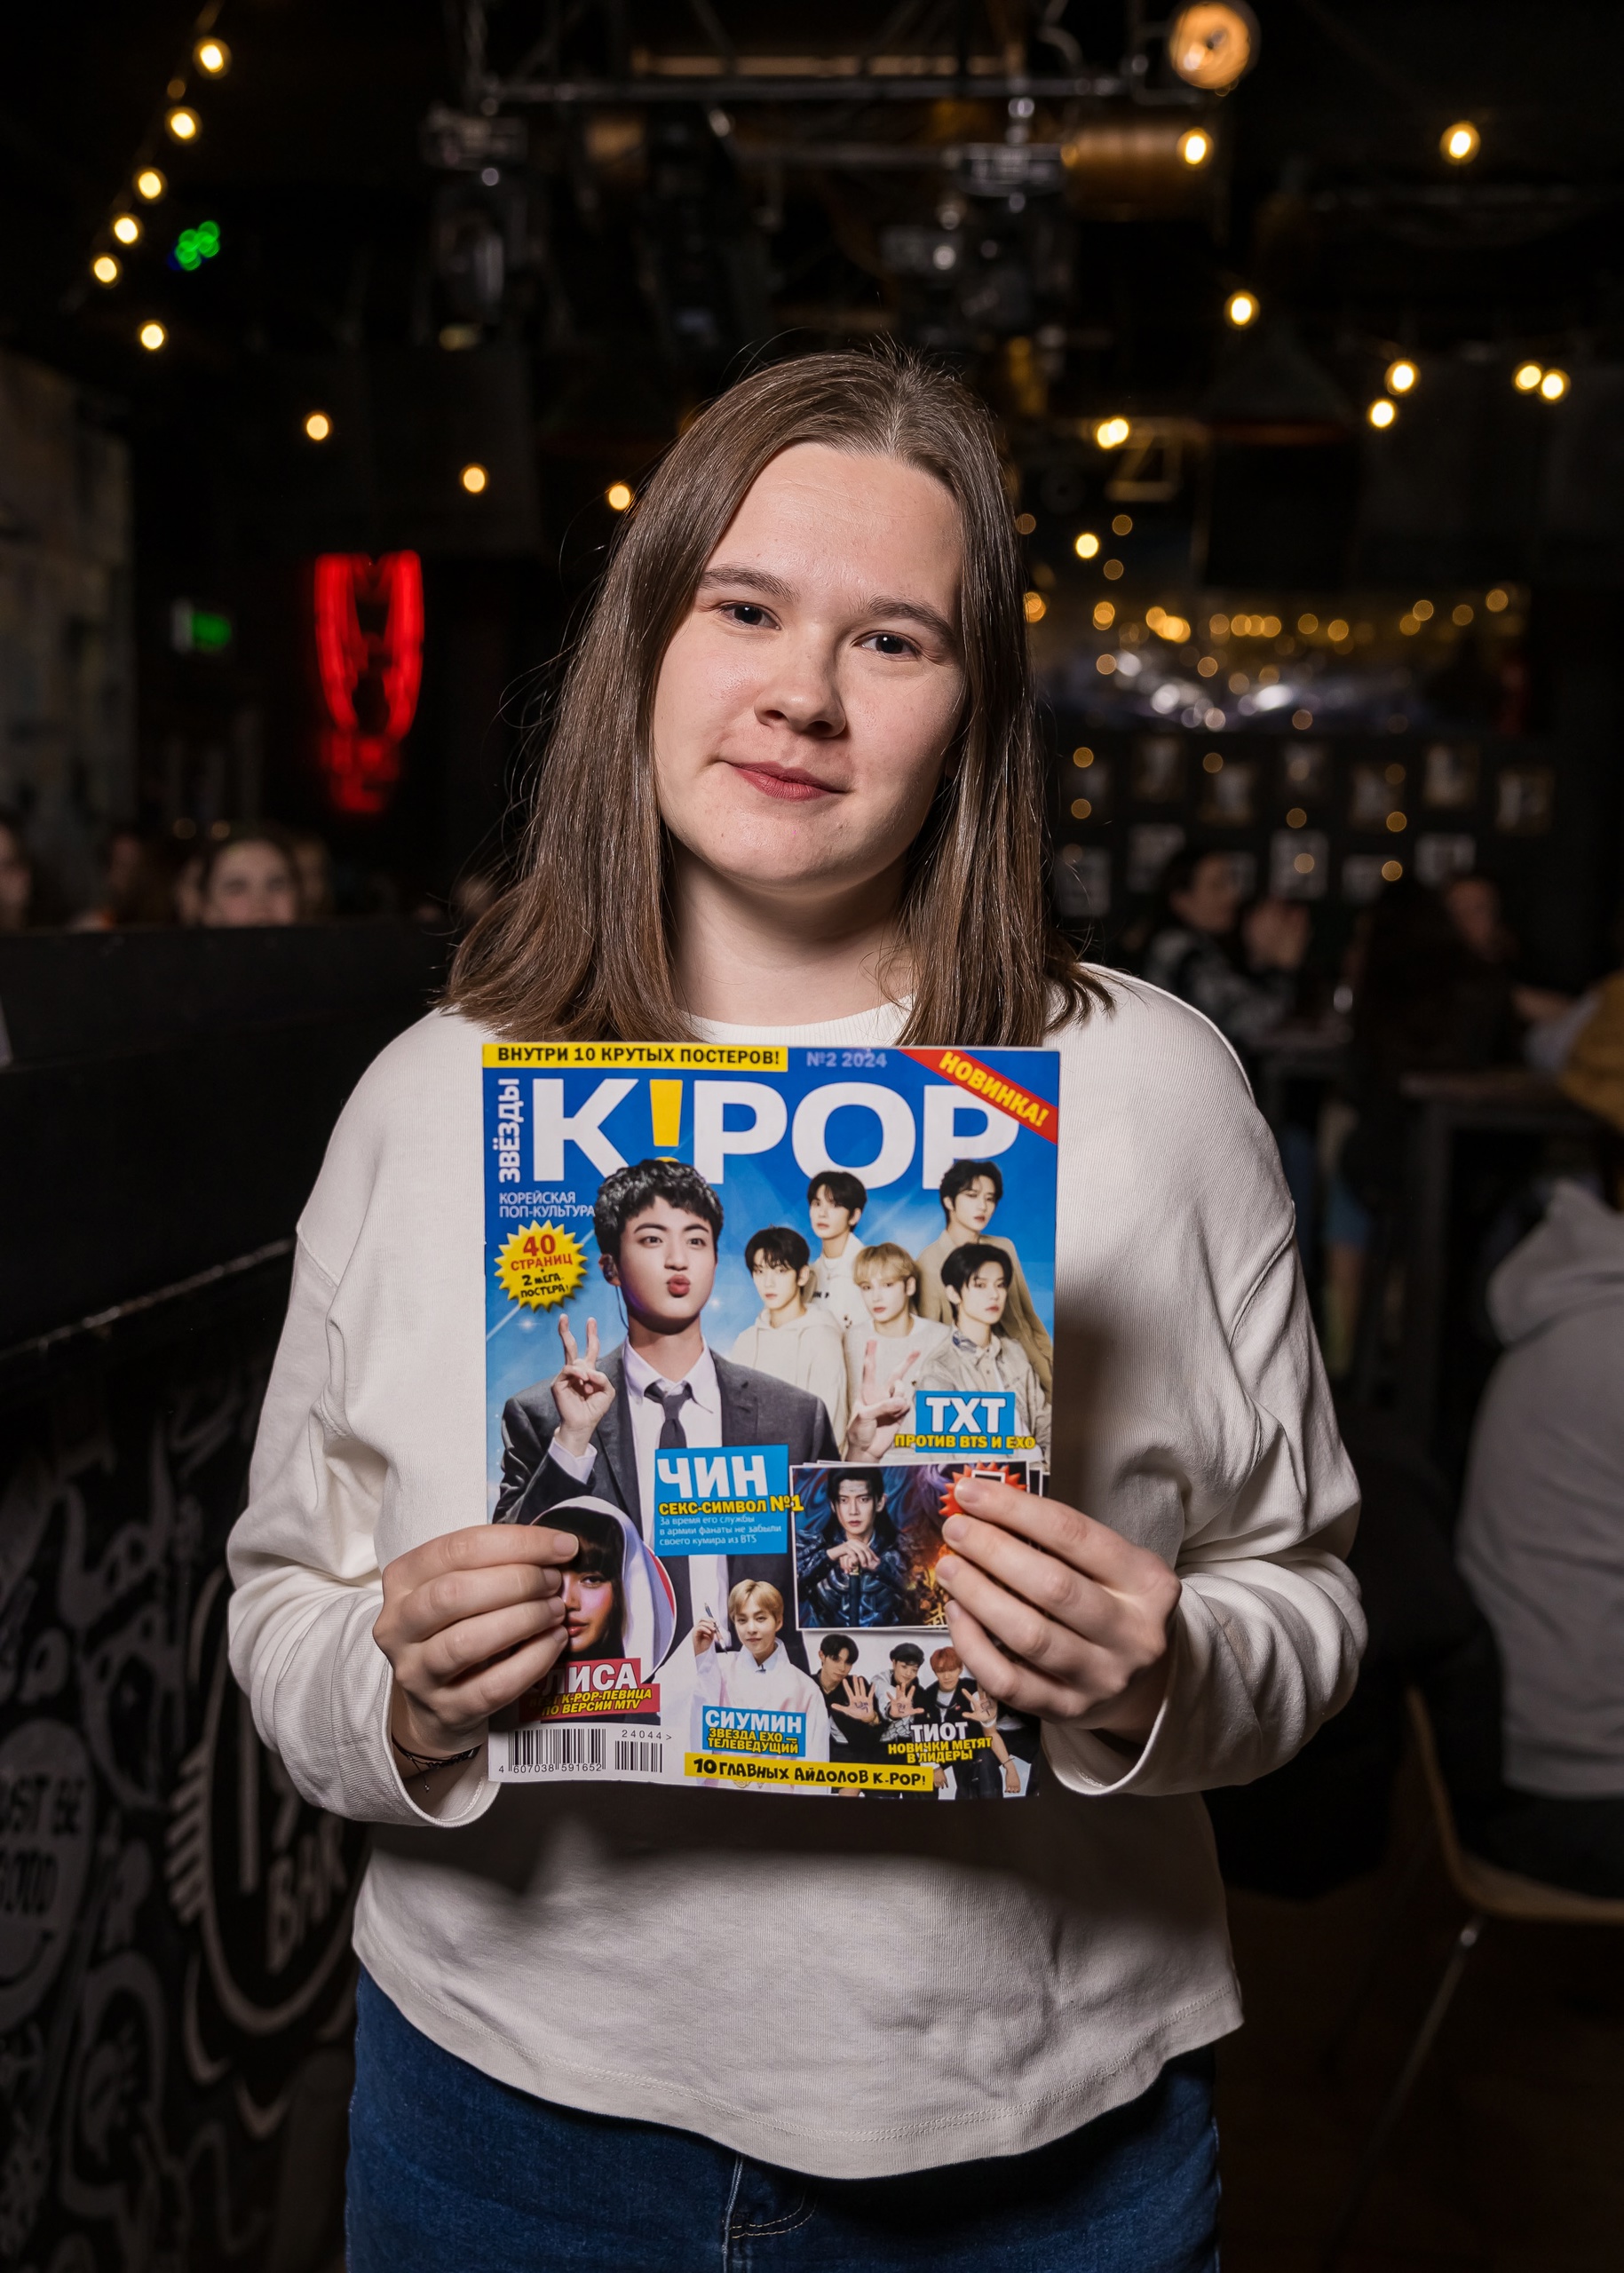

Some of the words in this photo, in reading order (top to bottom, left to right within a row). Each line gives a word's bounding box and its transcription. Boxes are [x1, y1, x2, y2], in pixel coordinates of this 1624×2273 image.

[498, 1047, 568, 1061] ВНУТРИ
[574, 1048, 596, 1061] 10
[601, 1049, 675, 1062] КРУТЫХ
[680, 1049, 780, 1065] ПОСТЕРОВ!
[842, 1052, 888, 1068] 2024
[939, 1050, 1050, 1128] НОВИНКА!
[493, 1078, 524, 1183] ЗВЁЗДЫ
[499, 1191, 576, 1205] КОРЕЙСКАЯ
[499, 1205, 596, 1218] ПОП-КУЛЬТУРА
[522, 1234, 556, 1256] 40
[511, 1253, 573, 1271] СТРАНИЦ
[521, 1274, 533, 1287] 2
[925, 1397, 1007, 1433] TXT
[894, 1434, 955, 1448] ПРОТИВ
[959, 1435, 987, 1448] BTS
[991, 1436, 1002, 1449] И
[656, 1455, 769, 1499] ЧИН
[658, 1499, 767, 1516] СЕКС-СИМВОЛ
[660, 1517, 669, 1525] За
[672, 1517, 701, 1526] время
[719, 1515, 755, 1525] службы
[667, 1527, 697, 1537] армии
[699, 1525, 733, 1536] фанаты
[748, 1524, 782, 1533] забыли
[659, 1538, 691, 1547] своего
[693, 1537, 726, 1547] кумира
[741, 1534, 757, 1544] BTS
[541, 1662, 638, 1696] ЛИСА
[541, 1704, 559, 1716] ПО
[561, 1700, 613, 1715] ВЕРСИИ
[614, 1699, 642, 1711] MTV
[705, 1709, 802, 1734] СИУМИН
[709, 1727, 757, 1741] ЗВЕЗДА
[910, 1722, 969, 1743] ТИОТ
[708, 1737, 799, 1754] ТЕЛЕВЕДУЩИЙ
[888, 1739, 950, 1755] НОВИЧКИ
[951, 1736, 993, 1751] МЕТЯТ
[907, 1752, 916, 1764] В
[918, 1749, 973, 1764] ЛИДЕРЫ
[513, 1764, 554, 1774] 607038
[561, 1763, 602, 1772] 591652
[693, 1757, 717, 1774] 10
[719, 1762, 790, 1780] ГЛАВНЫХ
[794, 1766, 869, 1784] АЙДОЛОВ
[873, 1770, 926, 1786] K-POP!
